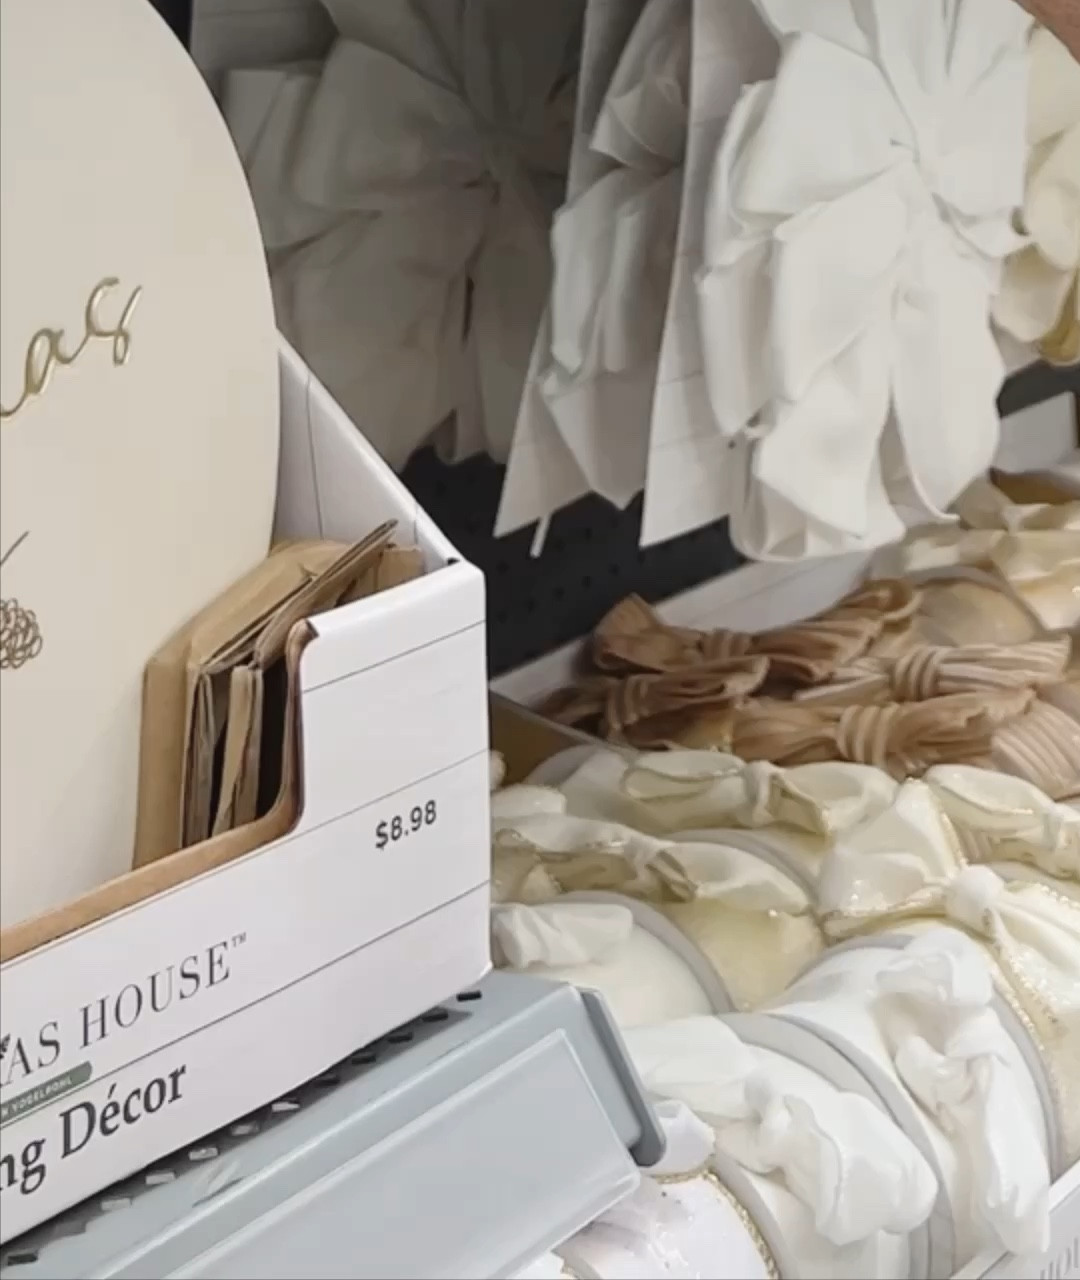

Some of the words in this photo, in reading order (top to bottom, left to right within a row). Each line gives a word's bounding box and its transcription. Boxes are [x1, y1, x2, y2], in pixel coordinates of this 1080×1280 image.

[375, 800, 437, 850] $8.98
[0, 1021, 61, 1088] AS
[60, 1065, 188, 1159] Décor
